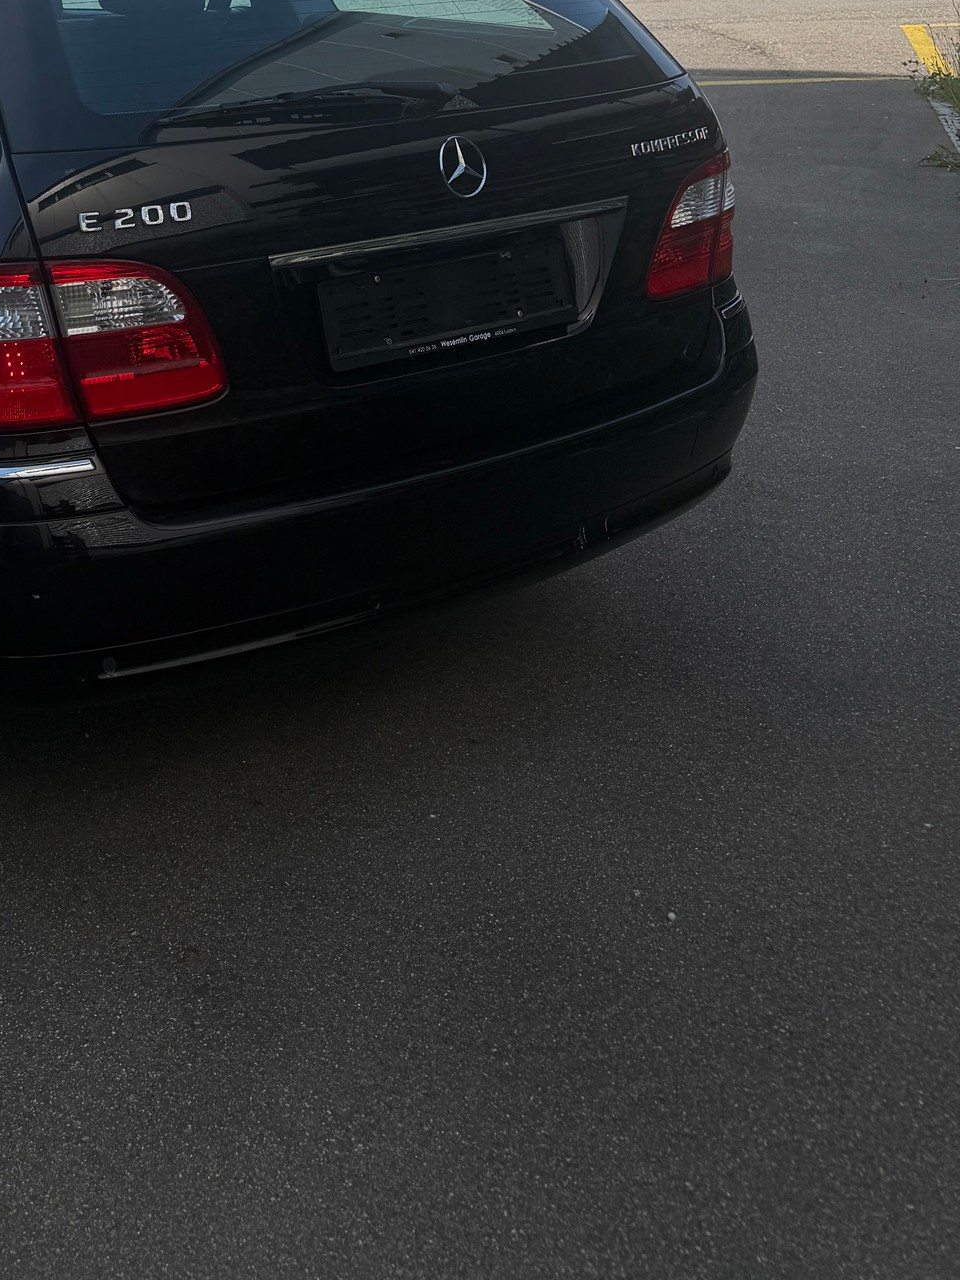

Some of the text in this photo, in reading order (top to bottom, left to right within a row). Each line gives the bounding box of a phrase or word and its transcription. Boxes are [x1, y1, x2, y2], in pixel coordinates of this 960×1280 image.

[630, 126, 709, 157] KOMPRESSOR
[79, 201, 192, 232] E 200
[440, 337, 468, 347] Wesemlin
[469, 332, 491, 342] Garage
